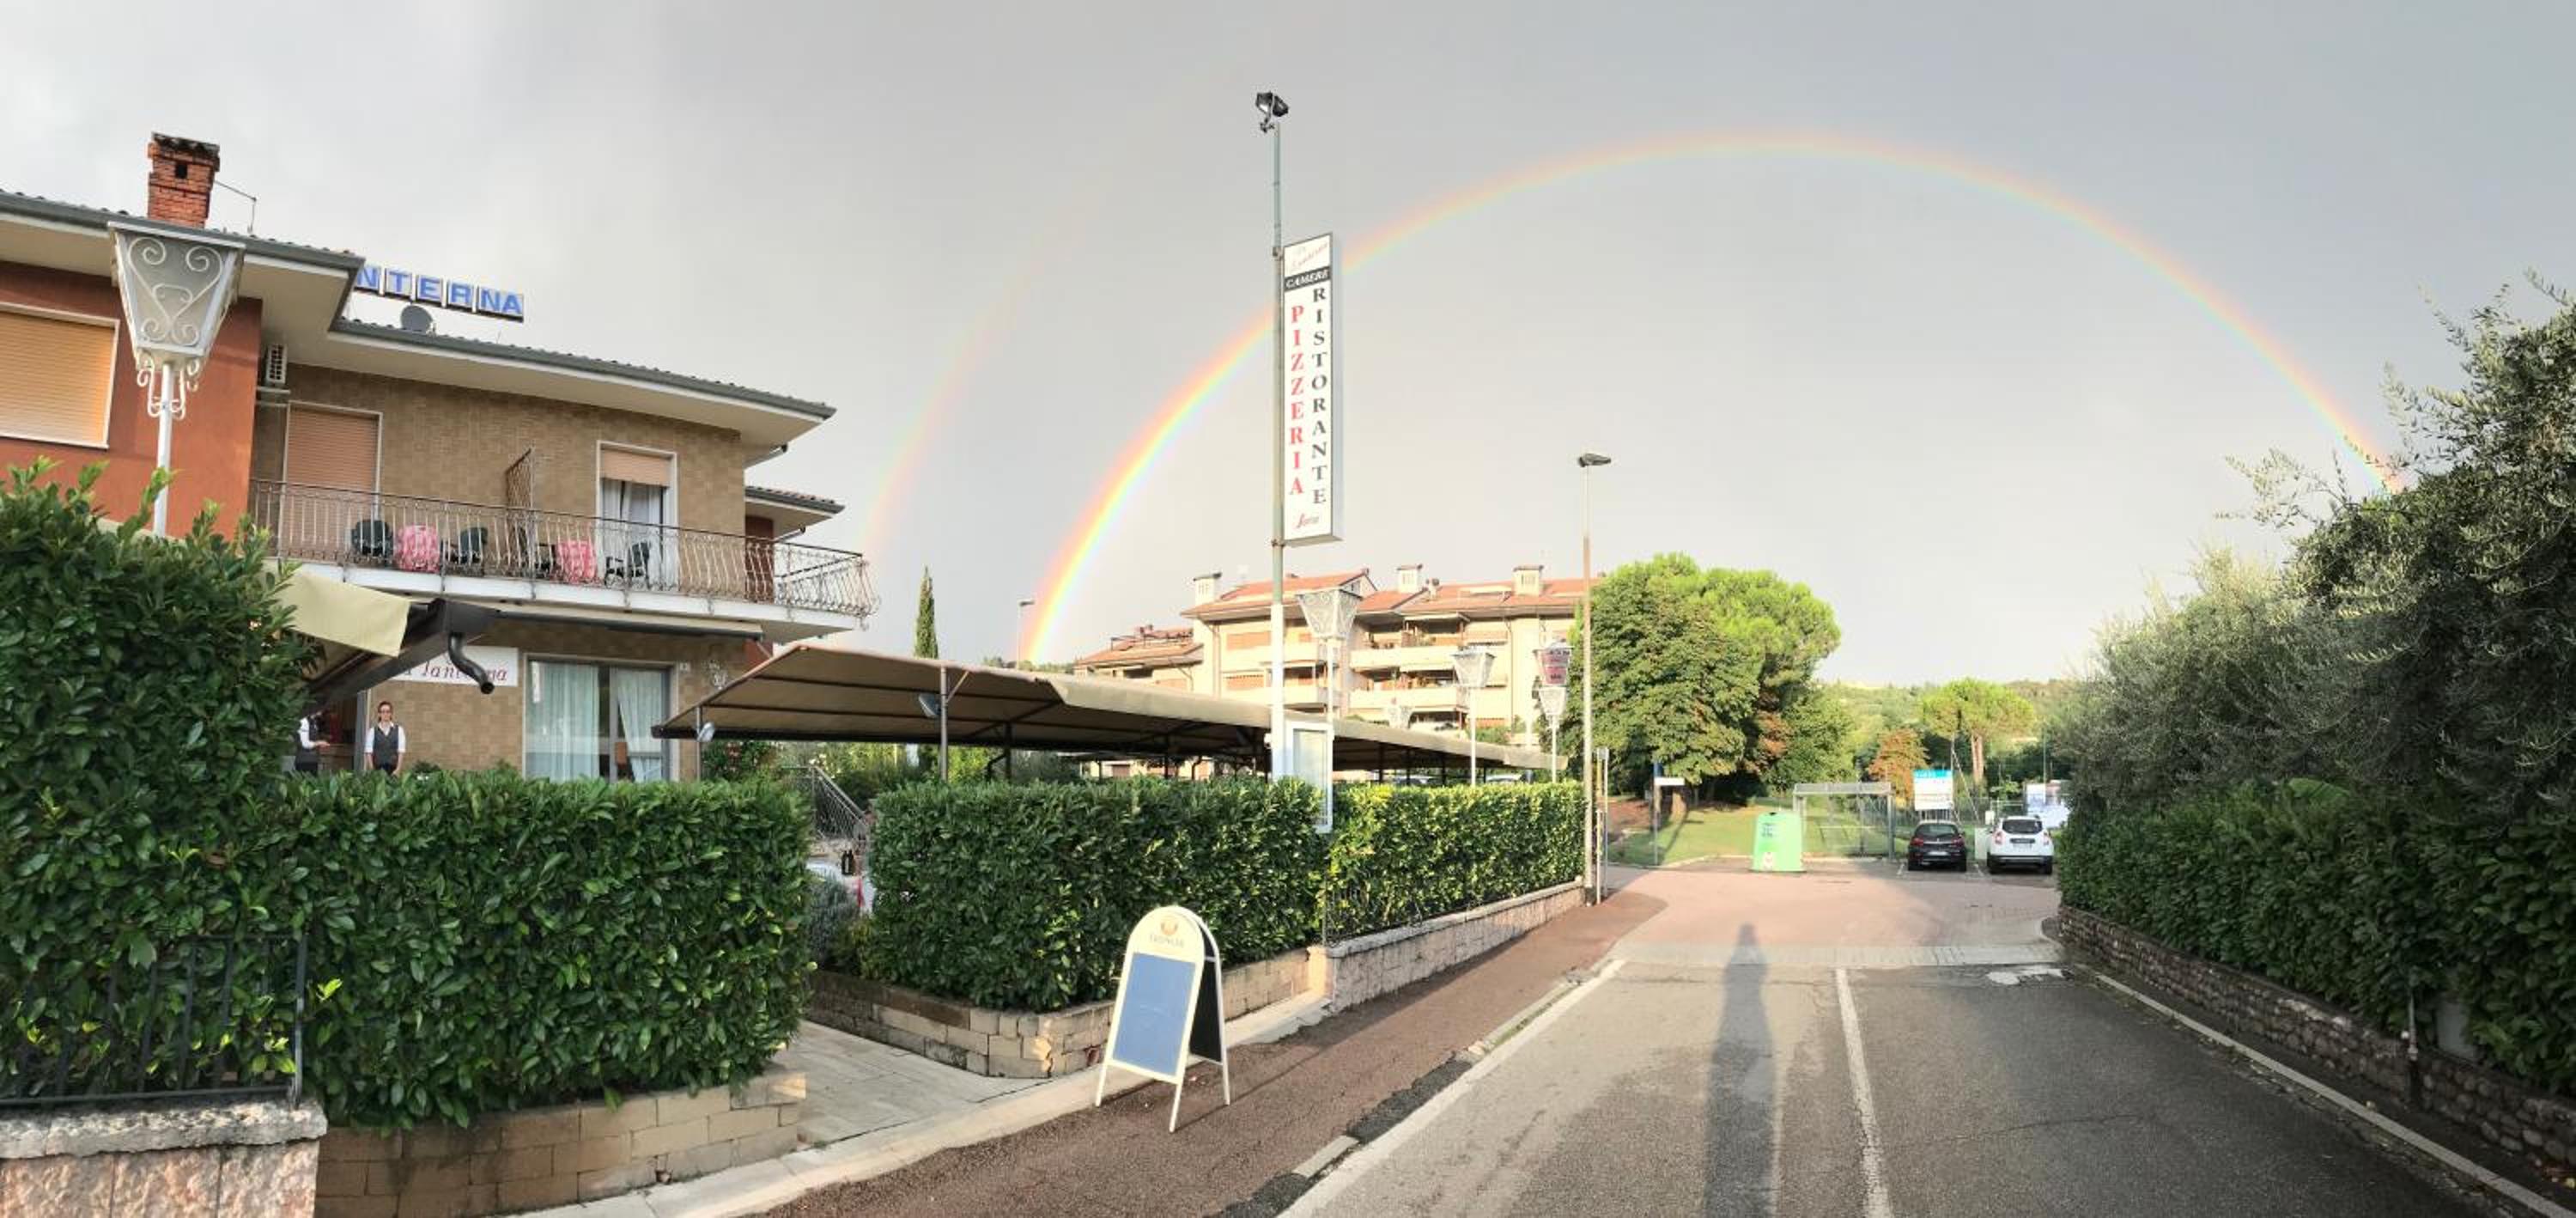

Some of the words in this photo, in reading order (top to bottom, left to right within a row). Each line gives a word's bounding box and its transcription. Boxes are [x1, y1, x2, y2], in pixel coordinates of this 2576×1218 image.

[1285, 269, 1329, 289] CAMERE
[1290, 305, 1304, 496] PIZZERIA
[1311, 287, 1328, 505] RISTORANTE
